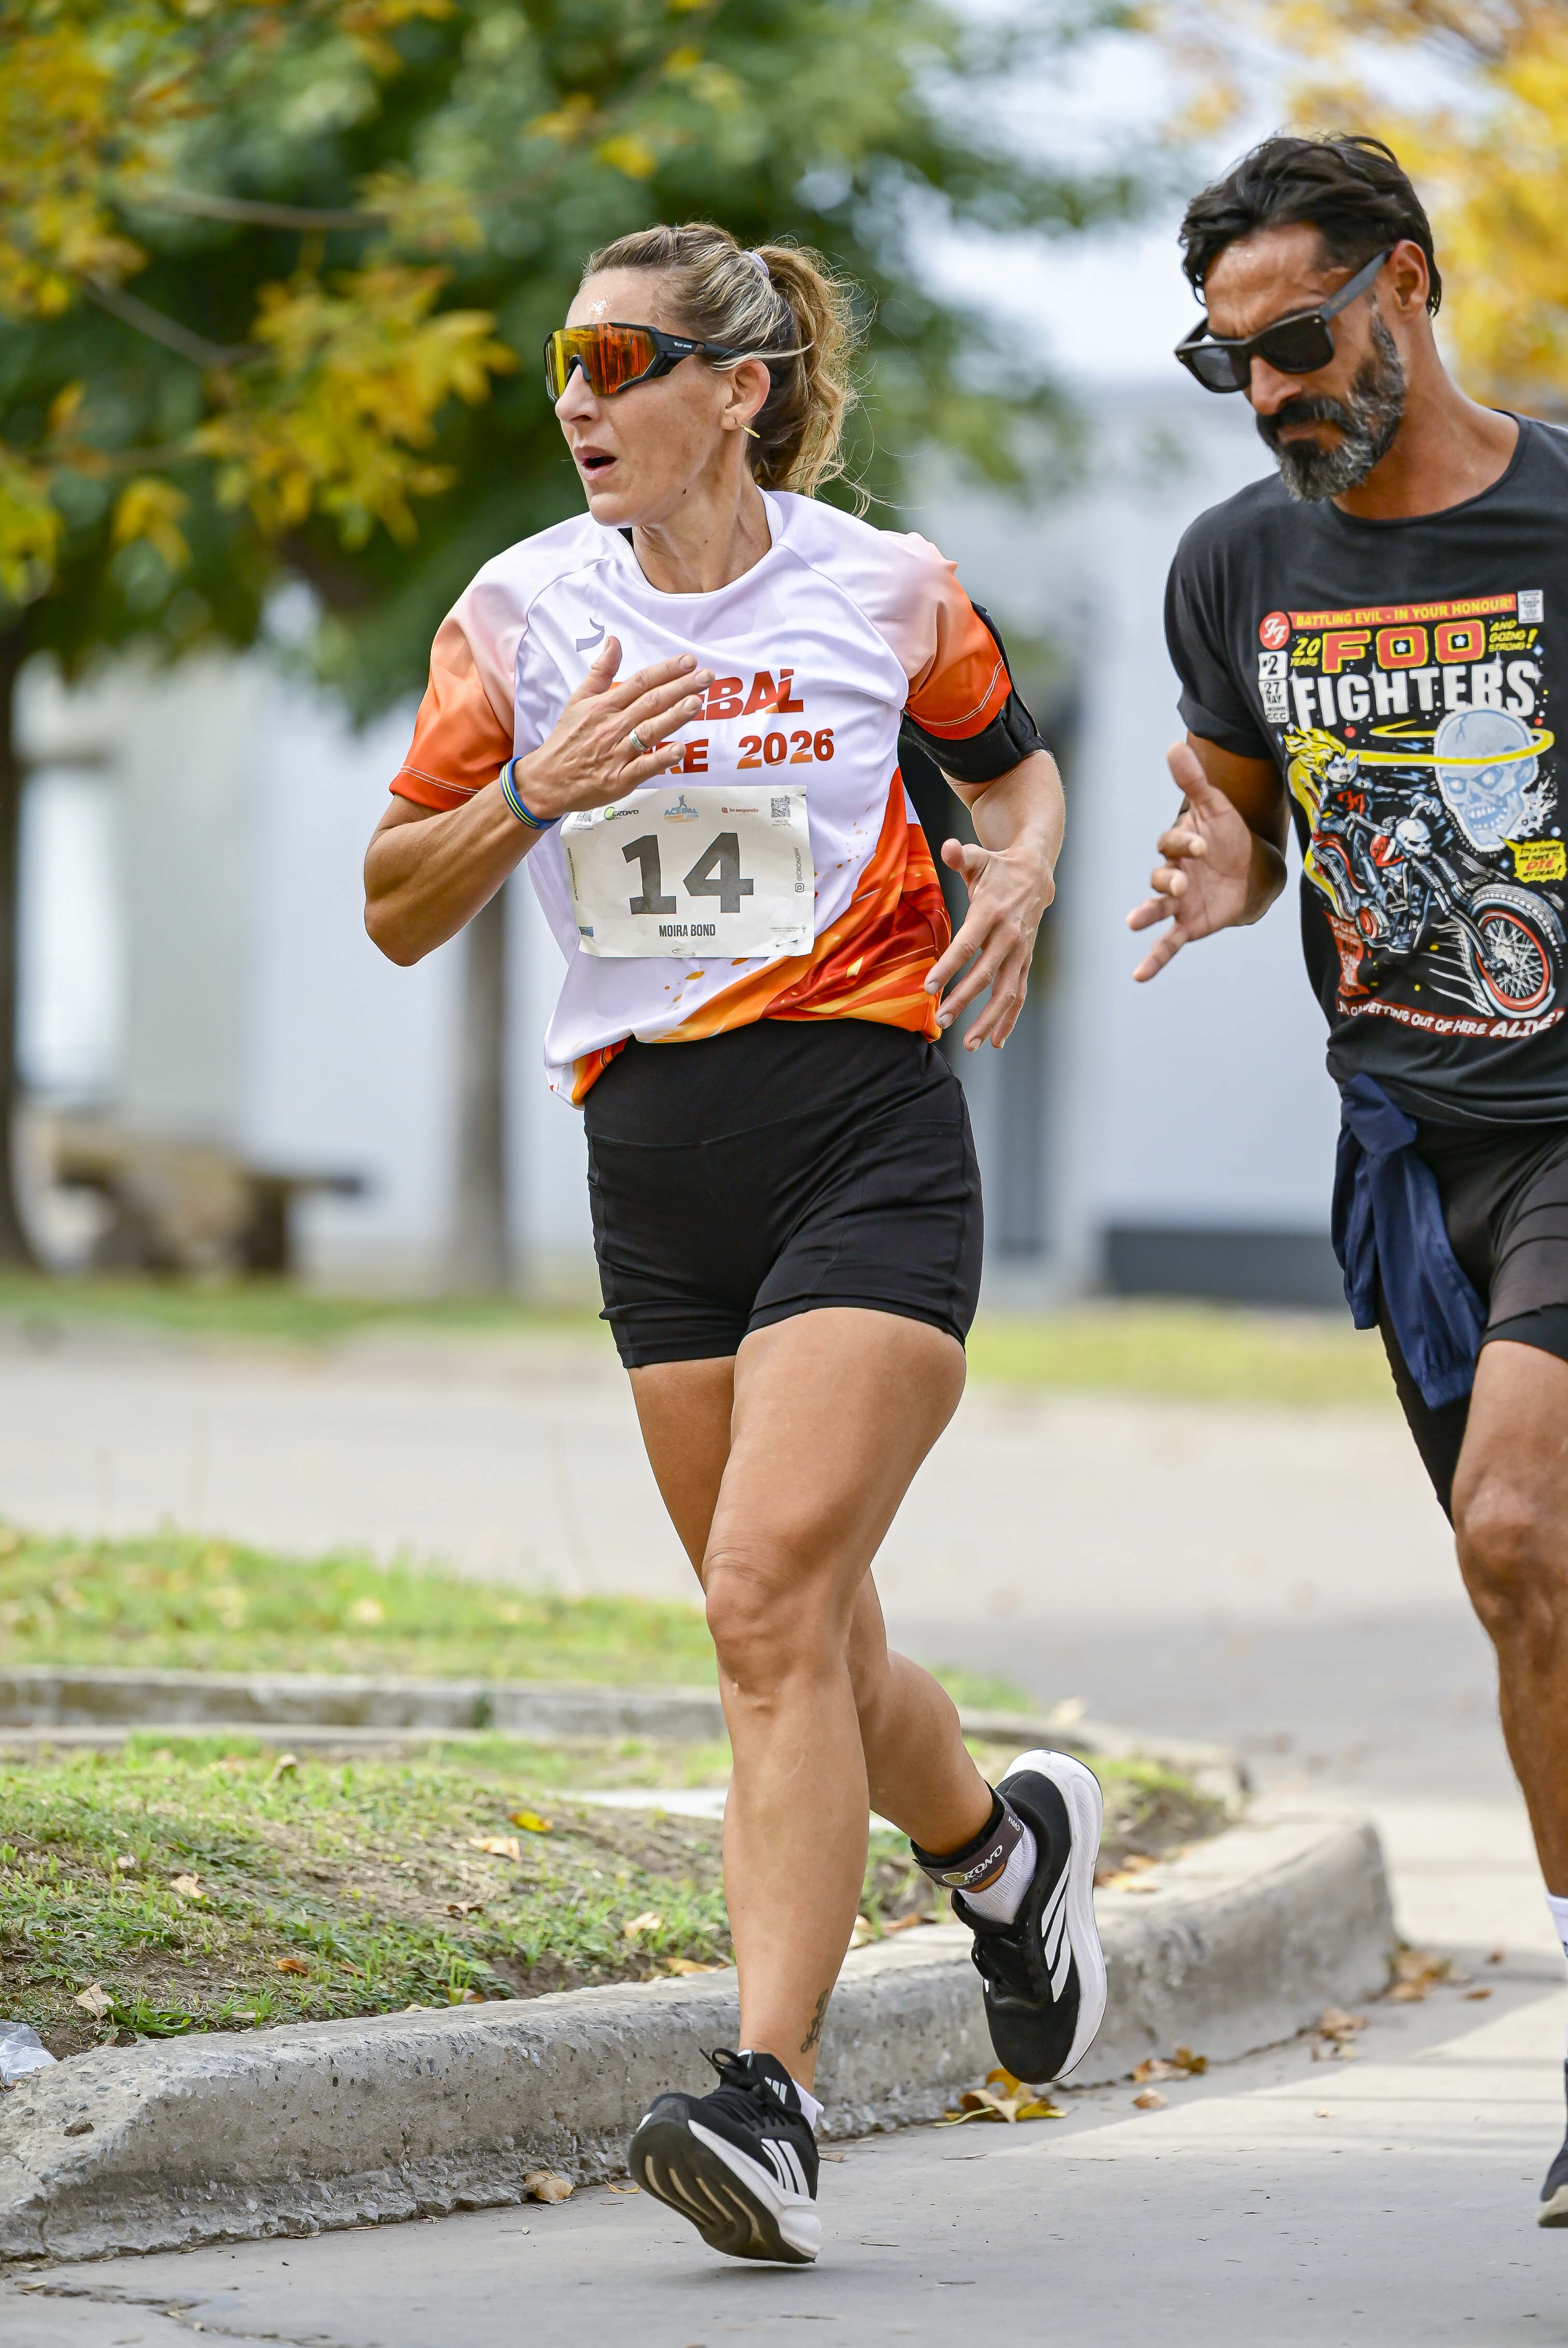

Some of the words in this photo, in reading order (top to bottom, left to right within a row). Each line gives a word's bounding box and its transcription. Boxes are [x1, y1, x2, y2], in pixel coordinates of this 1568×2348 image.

[1297, 612, 1352, 626] BATTLING
[1355, 611, 1382, 623] EVIL
[1394, 609, 1408, 621] IN
[1412, 605, 1448, 619] YOUR
[1452, 597, 1513, 615] HONOUR!
[1292, 637, 1321, 657] 20
[1322, 619, 1486, 674] FOO
[1264, 682, 1280, 694] 27
[1293, 661, 1536, 731] FIGHTERS
[737, 728, 834, 770] 2026
[622, 832, 754, 915] 14
[659, 925, 689, 938] MOIRA
[691, 924, 716, 937] BOND
[1411, 1013, 1435, 1028] OUT
[1452, 1019, 1488, 1035] HERE
[1008, 1815, 1020, 1832] CV014
